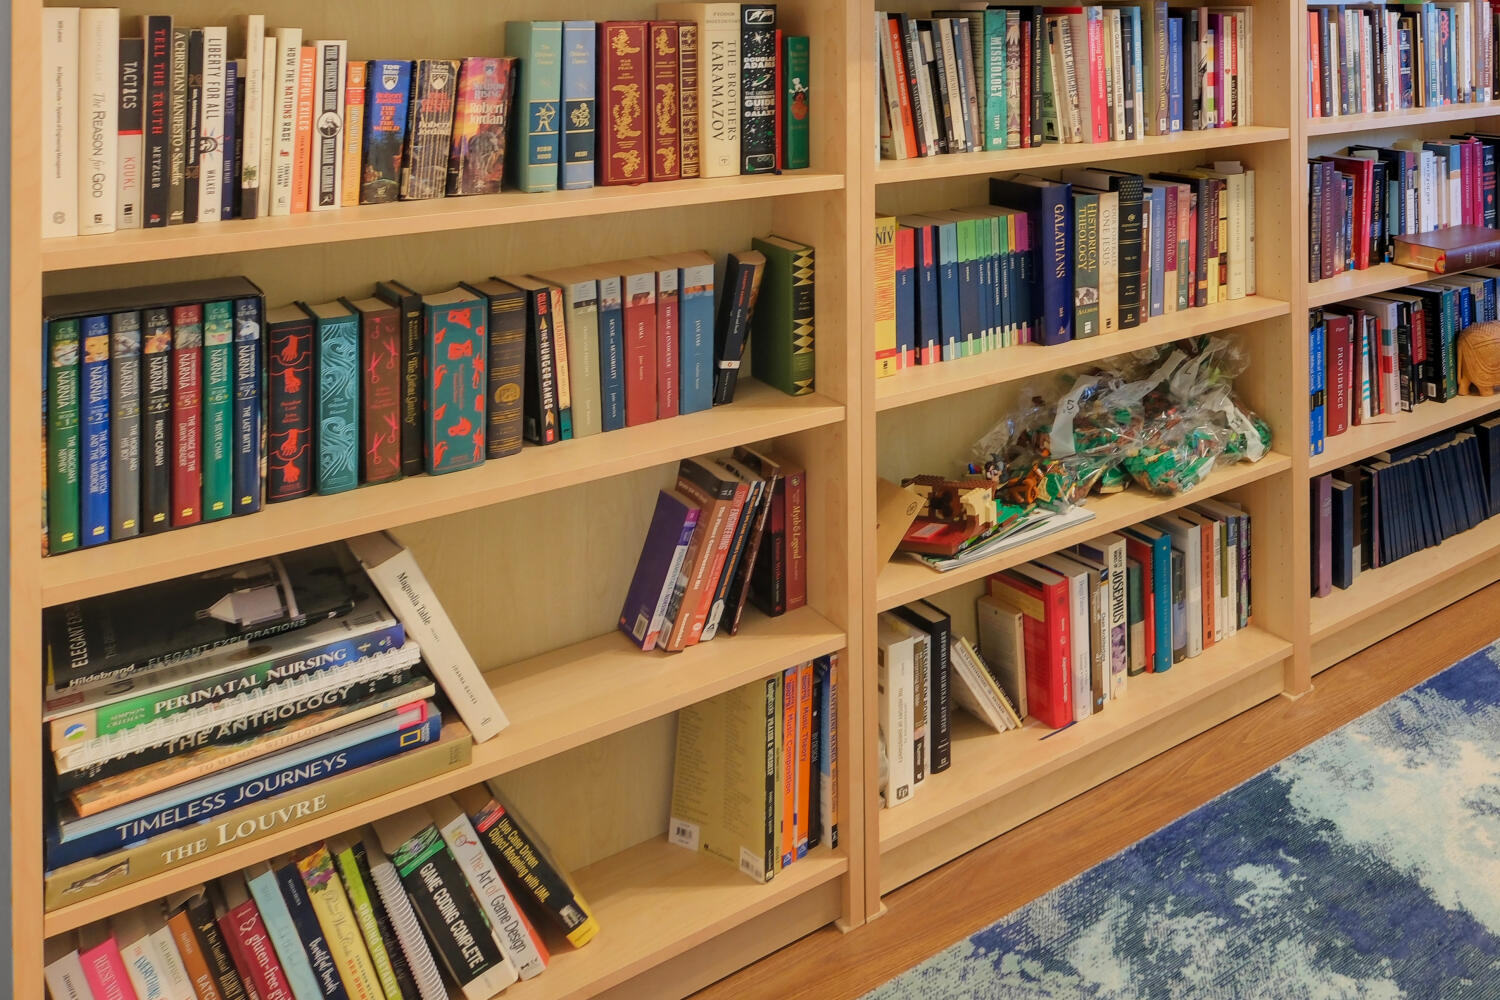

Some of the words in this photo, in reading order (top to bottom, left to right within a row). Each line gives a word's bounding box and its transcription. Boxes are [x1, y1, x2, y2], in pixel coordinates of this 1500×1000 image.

[154, 28, 166, 56] TELL
[174, 32, 185, 40] A
[727, 40, 736, 66] THE
[1061, 18, 1072, 59] COMEBACK
[153, 62, 164, 85] THE
[174, 41, 185, 93] CHRISTIAN
[207, 38, 222, 78] LIBERTY
[287, 47, 296, 66] HOW
[991, 36, 1001, 97] MISSIOLOGY
[123, 61, 138, 110] TACTICS
[206, 81, 220, 100] FOR
[285, 68, 295, 84] THE
[302, 58, 312, 100] FAITHFUL
[712, 40, 725, 141] KARAMAZOV
[1066, 60, 1077, 98] CHURCHES
[94, 94, 105, 108] The
[151, 93, 164, 134] TRUTH
[172, 94, 184, 146] MANIFESTO
[206, 102, 220, 120] ALL
[283, 86, 294, 119] NATIONS
[299, 101, 312, 131] EXILES
[470, 114, 504, 124] Jordan
[471, 102, 504, 114] Robert
[728, 73, 737, 141] BROTHERS
[744, 110, 776, 118] GALAXY
[92, 110, 107, 156] REASON
[281, 121, 292, 142] RAGE
[92, 157, 103, 172] for
[124, 157, 136, 190] KOUKL
[152, 146, 162, 188] METZGER
[206, 170, 216, 195] WALKER
[92, 172, 106, 198] GOD
[876, 231, 893, 244] NIV
[1054, 204, 1065, 278] GALATIANS
[1078, 207, 1087, 270] THEOLOGY
[1087, 203, 1097, 273] HISTORICAL
[1102, 210, 1111, 234] ONE
[1102, 237, 1111, 265] JESUS
[538, 292, 546, 315] COLLINS
[540, 329, 548, 340] THE
[150, 356, 162, 394] NARNIA
[179, 353, 190, 390] NARNIA
[210, 350, 222, 385] NARNIA
[239, 345, 250, 380] NARNIA
[540, 342, 551, 378] HUNGER
[57, 370, 70, 408] NARNIA
[90, 366, 102, 404] NARNIA
[120, 361, 132, 398] NARNIA
[542, 380, 553, 410] GAMES
[397, 572, 420, 606] Magnolia
[416, 604, 431, 626] Table
[1112, 570, 1123, 623] JOSEPHUS
[69, 624, 88, 668] ELEGANT
[149, 644, 210, 668] ELEGANT
[213, 618, 308, 648] EXPLORATIONS
[69, 664, 135, 687] Hildebrand
[154, 673, 261, 714] PERINATAL
[268, 648, 348, 679] NURSING
[166, 727, 208, 754] THE
[215, 682, 355, 740] ANTHOLOGY
[116, 792, 226, 840] TIMELESS
[233, 753, 348, 802] JOURNEYS
[162, 840, 208, 866] THE
[216, 793, 327, 846] LOUVRE
[498, 818, 510, 834] Use
[508, 832, 522, 849] Case
[520, 846, 539, 868] Driven
[488, 828, 507, 852] Object
[504, 848, 527, 878] Modeling
[522, 872, 538, 889] with
[535, 885, 550, 904] UML
[420, 862, 444, 892] GAME
[433, 888, 460, 927] CODING
[450, 920, 484, 968] COMPLETE
[469, 851, 482, 870] The
[477, 870, 492, 889] Art
[486, 887, 496, 896] of
[491, 894, 511, 924] Game
[504, 920, 526, 953] Design
[360, 903, 378, 946] GROWING
[373, 946, 398, 998] VEGETABLES
